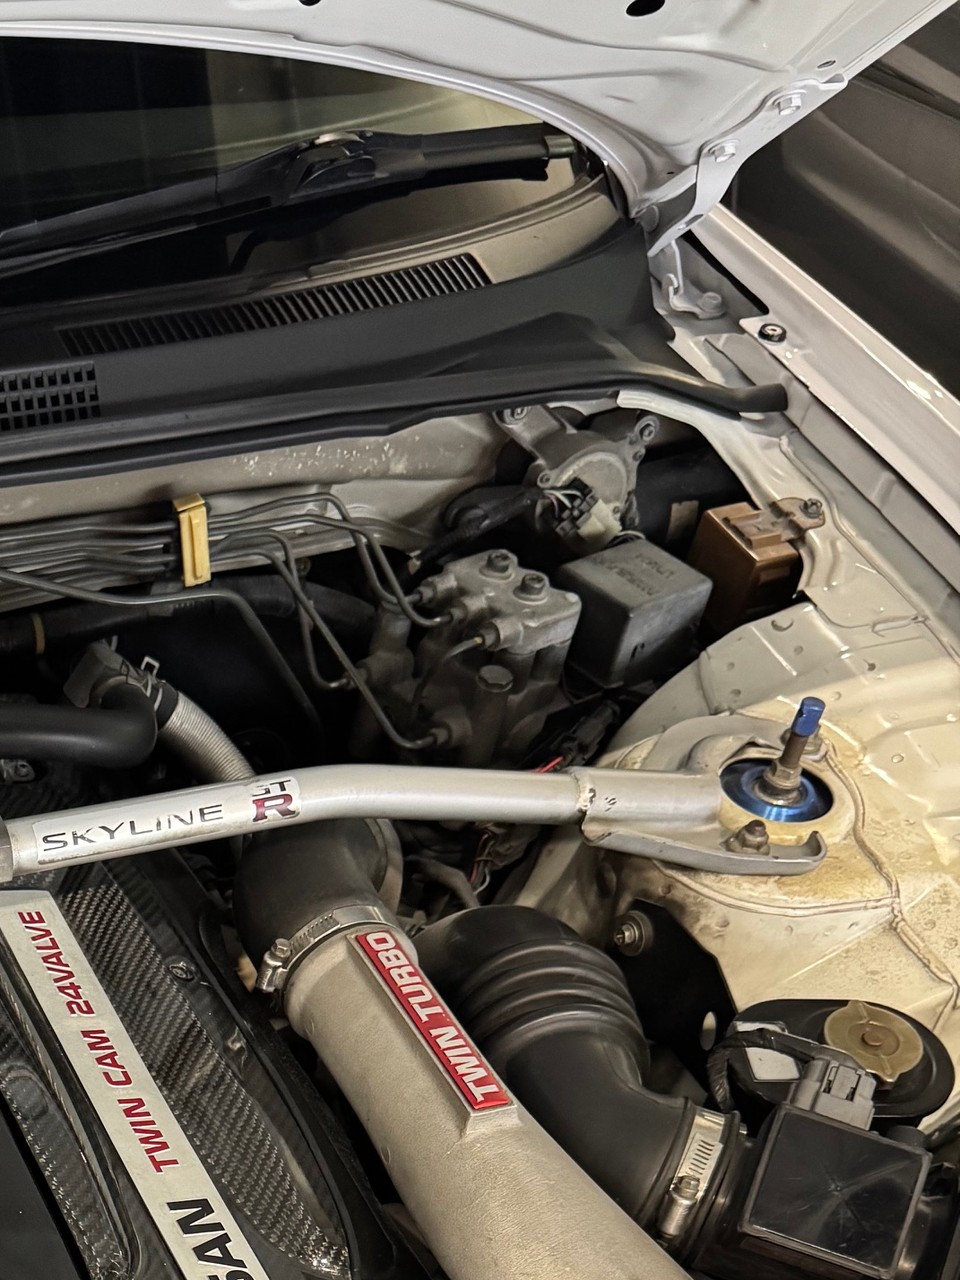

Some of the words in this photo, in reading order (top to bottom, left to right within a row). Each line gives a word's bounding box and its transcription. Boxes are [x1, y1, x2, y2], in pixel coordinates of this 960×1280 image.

[42, 804, 223, 852] SKYLINE
[252, 793, 296, 822] R
[18, 911, 95, 1015] 24VALVE
[366, 931, 444, 1023] TURBO
[80, 1029, 133, 1086] CAM
[429, 1026, 499, 1102] TWIN
[117, 1097, 179, 1173] TWIN
